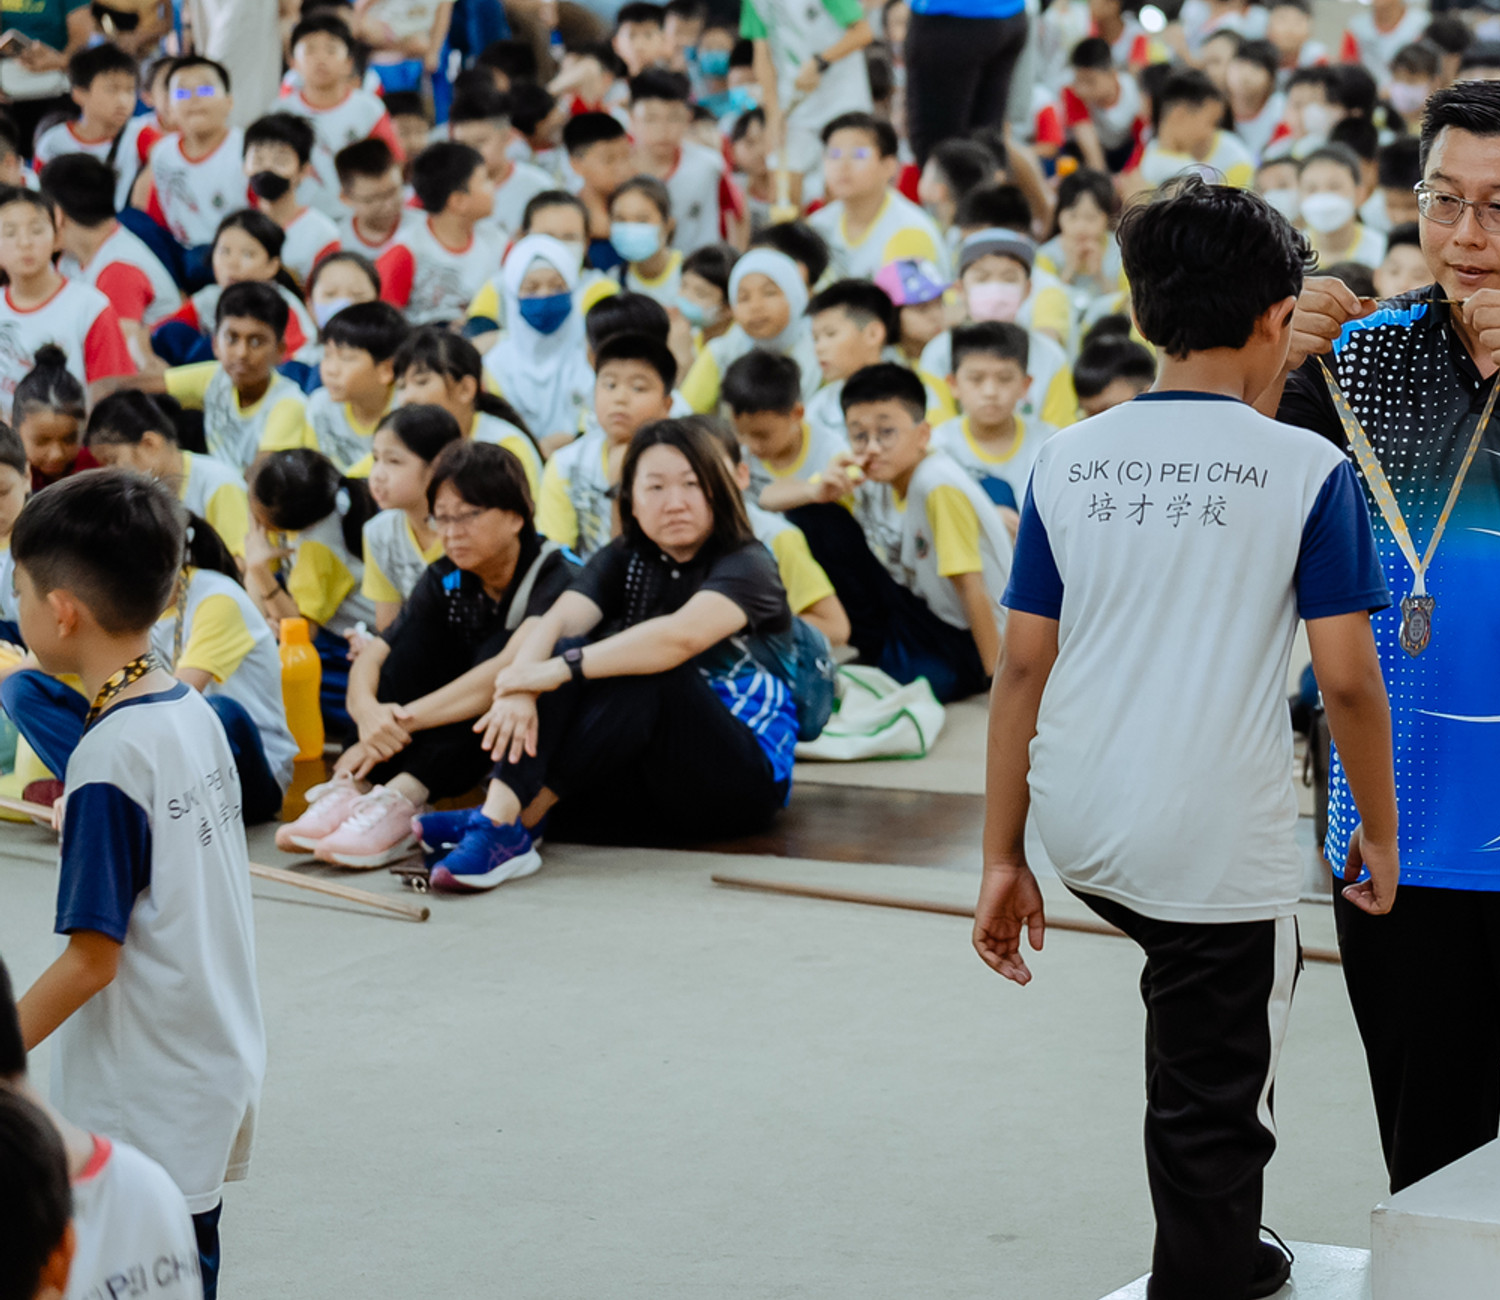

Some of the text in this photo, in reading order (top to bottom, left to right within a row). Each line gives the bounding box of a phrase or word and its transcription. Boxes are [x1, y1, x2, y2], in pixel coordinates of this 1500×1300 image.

[1068, 460, 1269, 489] SJK (C) PEI CHAI
[1088, 492, 1228, 528] 培才学校
